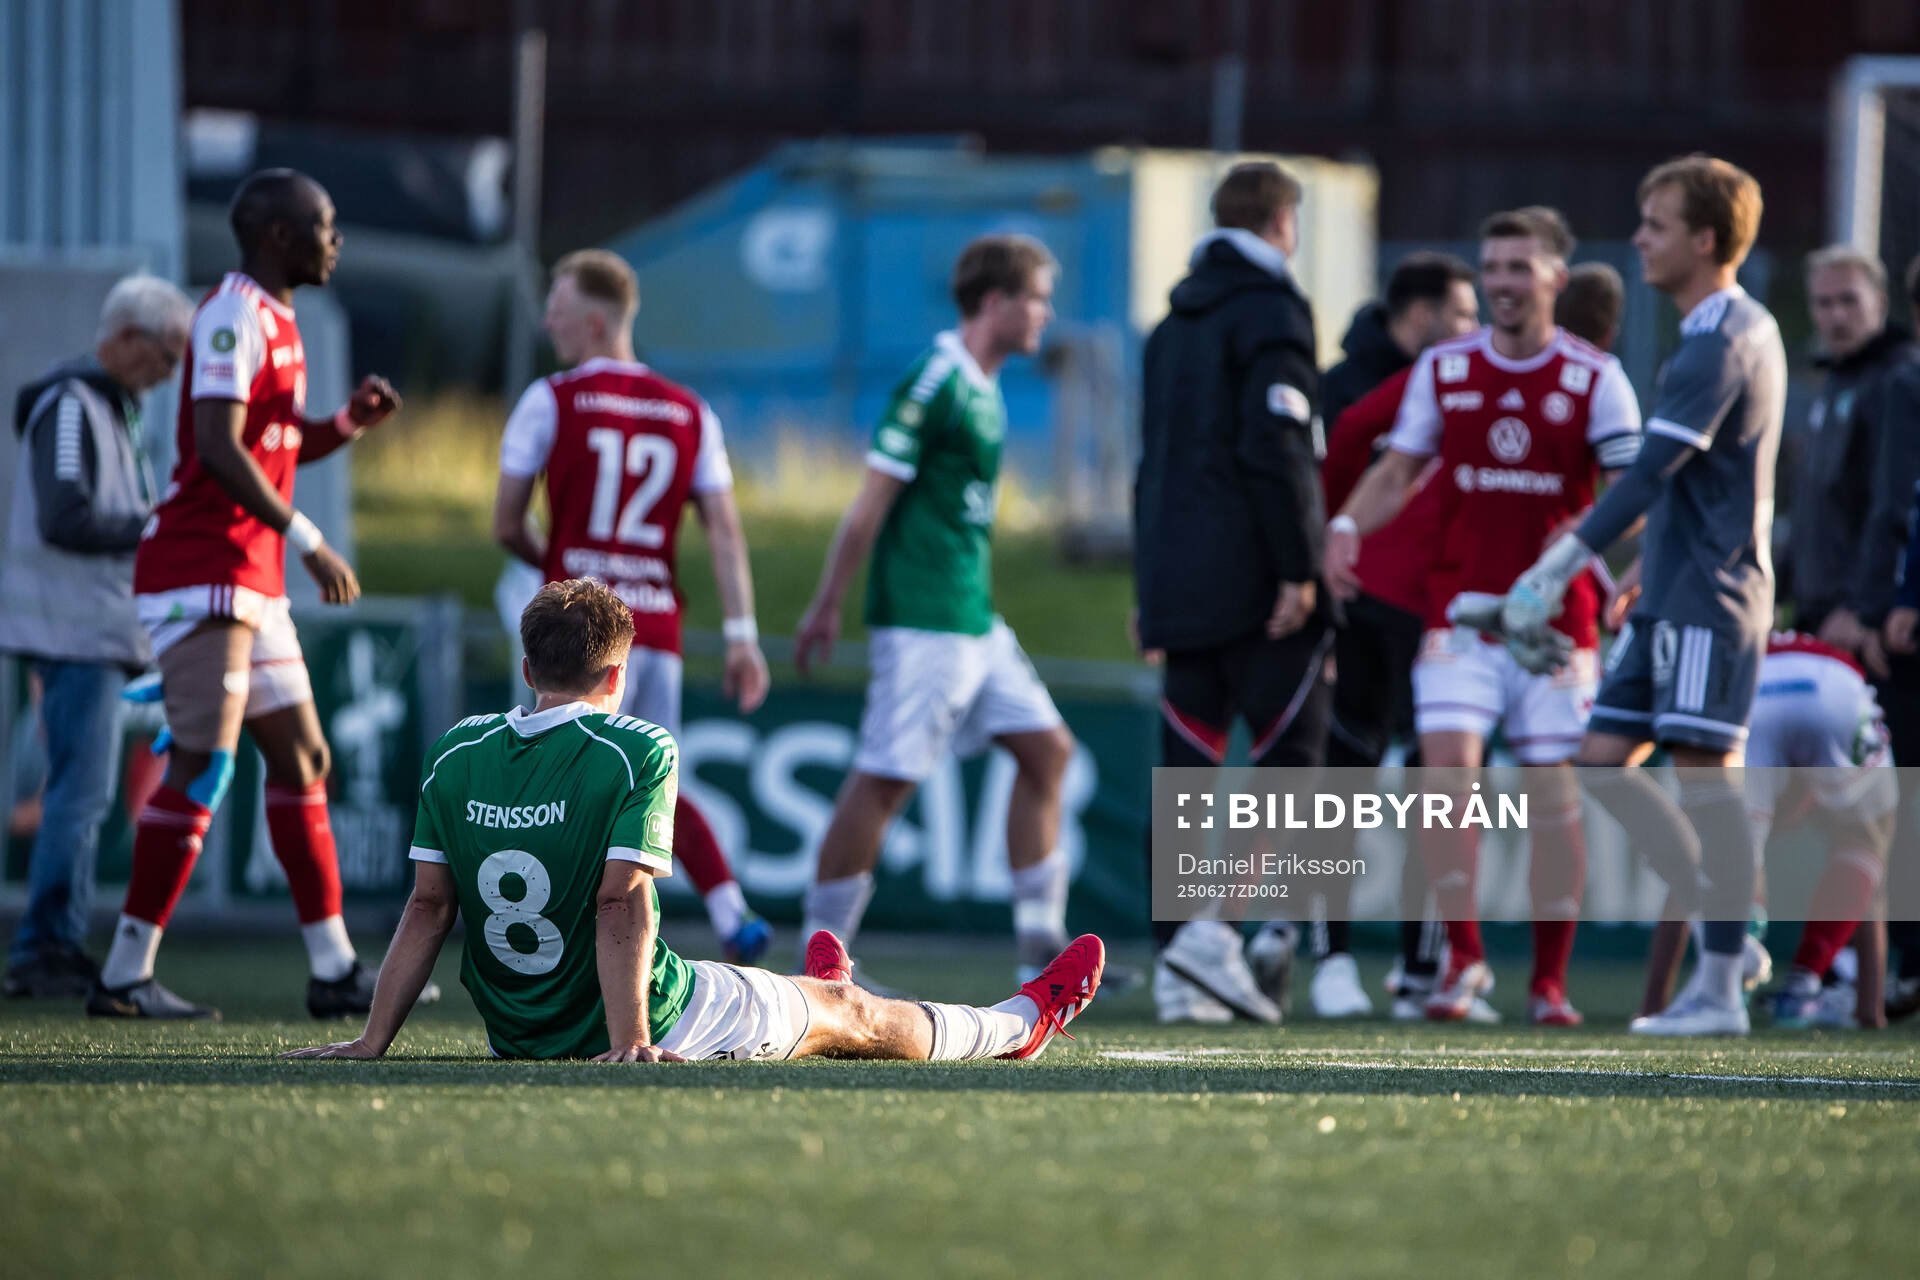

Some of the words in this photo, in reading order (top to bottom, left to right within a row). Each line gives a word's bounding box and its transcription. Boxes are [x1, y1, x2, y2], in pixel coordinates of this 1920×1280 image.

[587, 427, 678, 549] 12
[466, 800, 566, 829] STENSSON
[477, 849, 564, 975] 8
